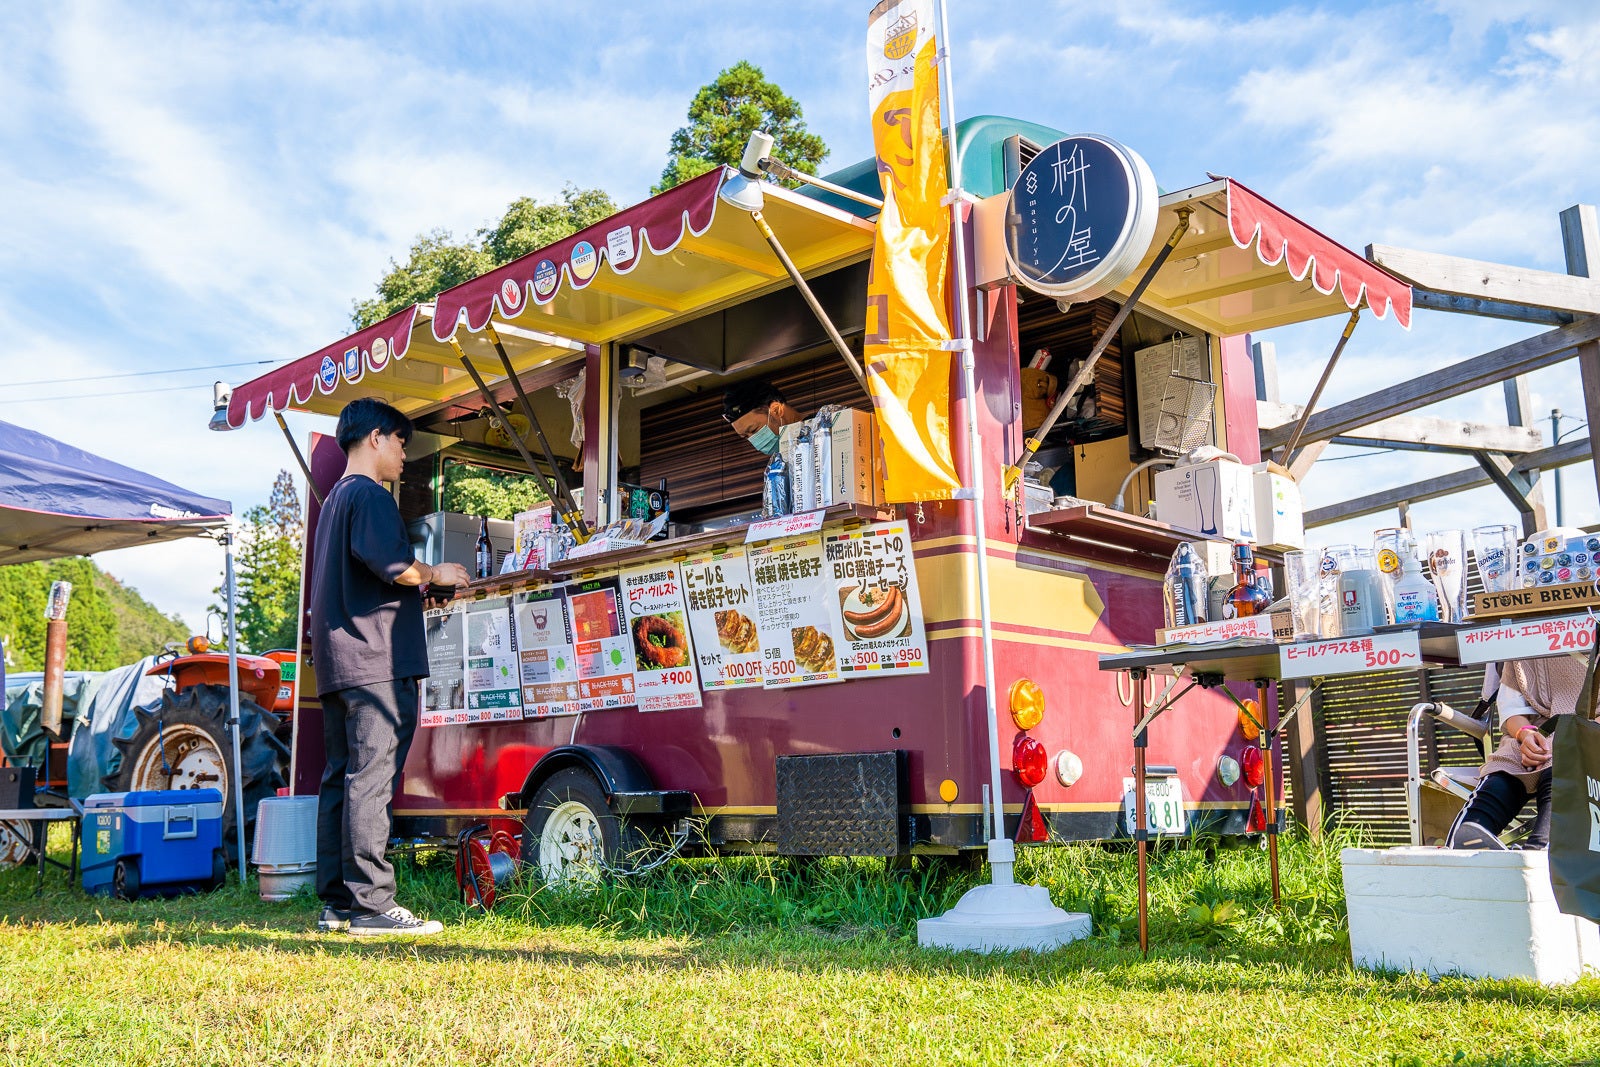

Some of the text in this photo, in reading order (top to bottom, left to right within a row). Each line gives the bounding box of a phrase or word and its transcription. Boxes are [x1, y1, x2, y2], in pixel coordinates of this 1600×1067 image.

[1186, 471, 1191, 479] 6
[834, 555, 907, 579] BIG醤油チーズ
[858, 573, 909, 594] ソーセージ
[689, 584, 749, 611] 焼き餃子セット
[1173, 583, 1186, 627] DON'T THIN
[850, 651, 878, 664] ¥500
[892, 648, 921, 661] ¥950
[1287, 638, 1374, 660] ビールグラス各種
[1365, 648, 1416, 668] 500〜
[764, 659, 796, 676] ¥500
[661, 670, 692, 684] ¥900
[537, 706, 549, 714] 850
[564, 703, 579, 712] 1250
[592, 699, 603, 708] 900
[619, 695, 635, 705] 1300
[454, 713, 468, 722] 1250
[505, 709, 520, 718] 1200
[1155, 783, 1169, 796] 800
